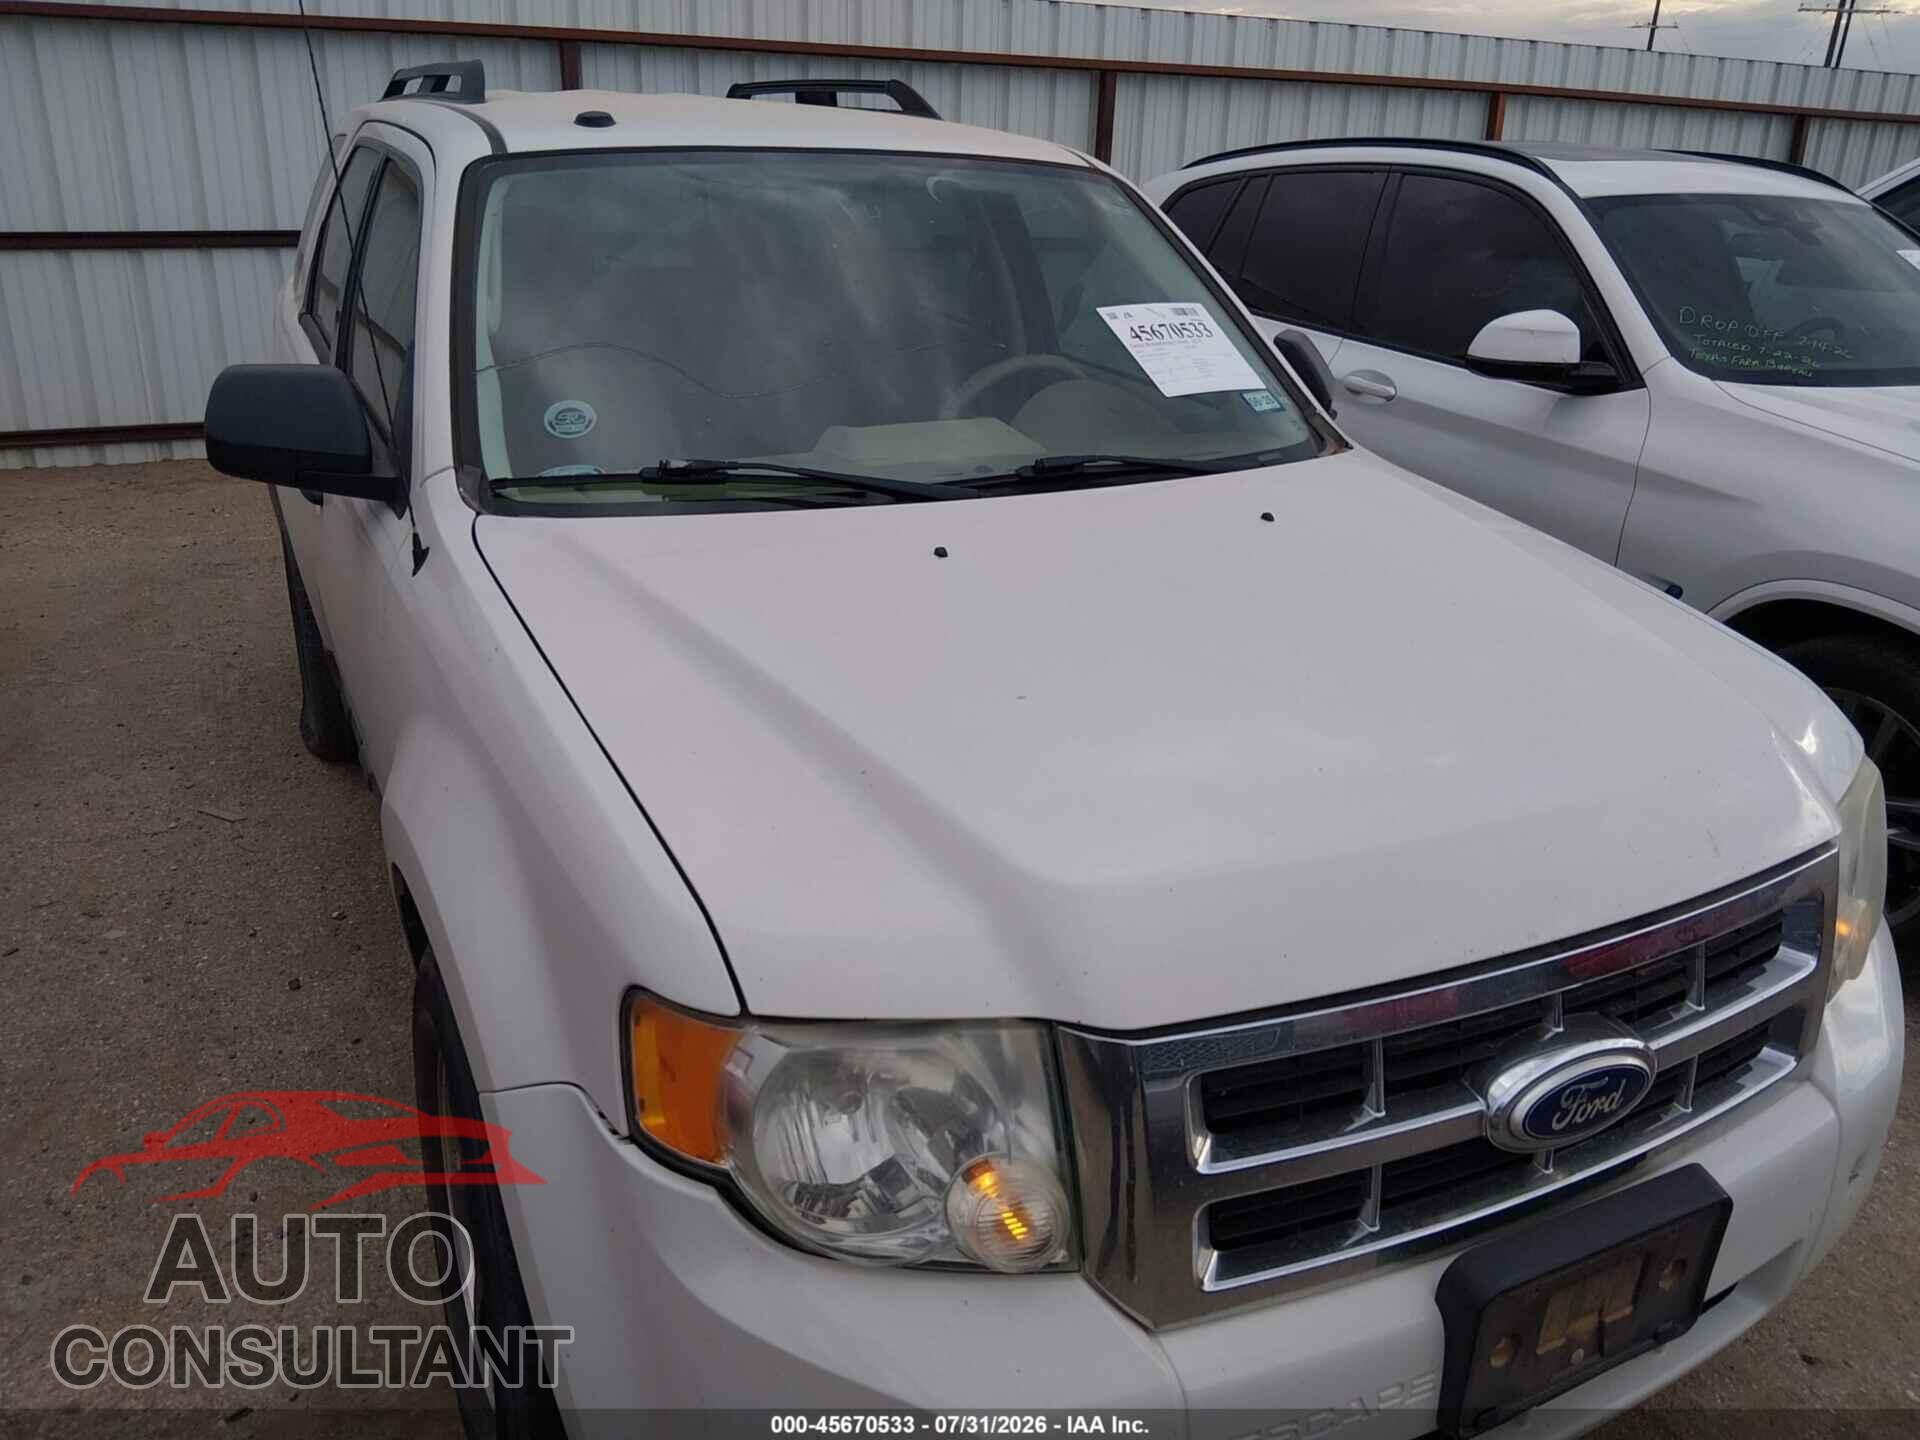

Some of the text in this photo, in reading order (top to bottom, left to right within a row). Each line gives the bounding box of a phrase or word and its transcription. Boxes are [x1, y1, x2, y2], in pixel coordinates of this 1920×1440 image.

[1129, 322, 1214, 342] 45670533
[1680, 306, 1738, 332] DROP
[1551, 1076, 1627, 1131] Ford
